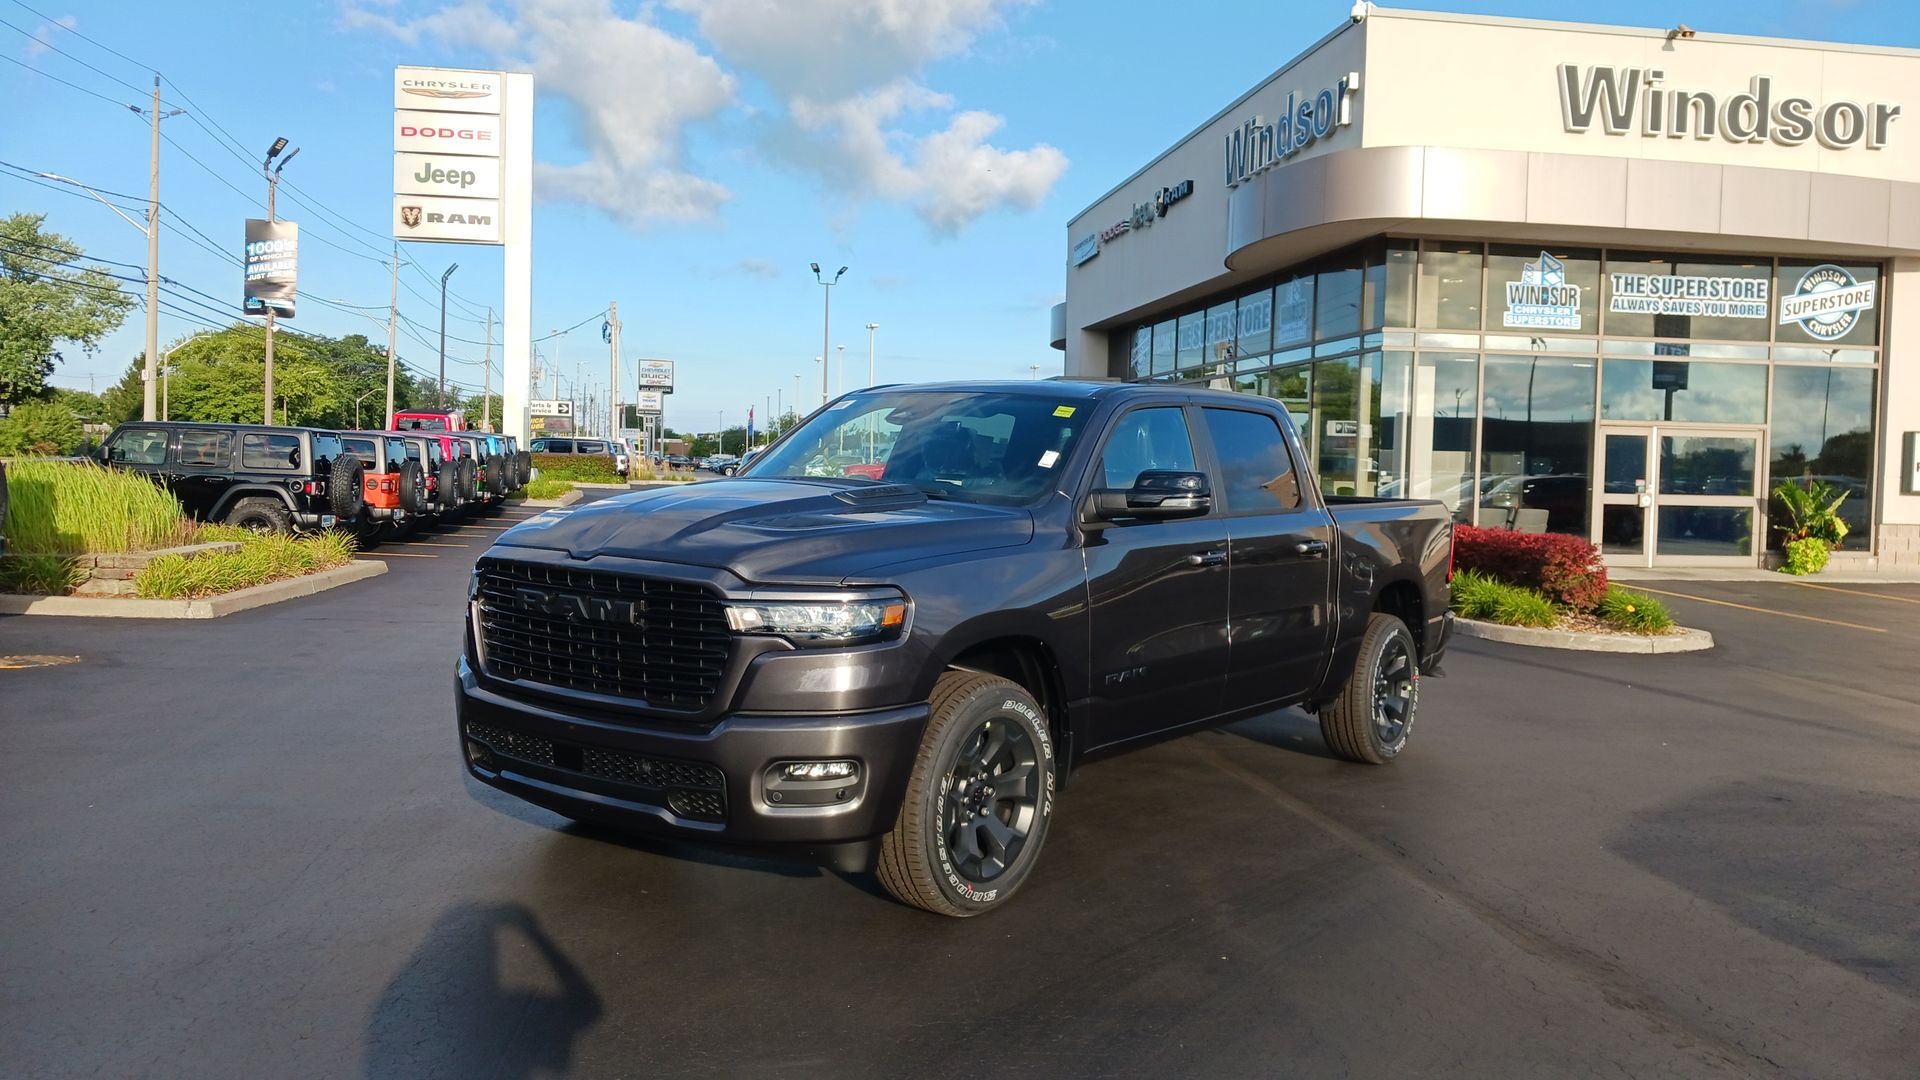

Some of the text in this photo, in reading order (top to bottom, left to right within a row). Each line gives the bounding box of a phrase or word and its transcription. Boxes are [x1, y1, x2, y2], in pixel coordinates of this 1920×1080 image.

[403, 79, 491, 91] CHRYSLER
[1557, 62, 1901, 151] Windsor
[401, 126, 492, 141] DODGE
[1225, 75, 1352, 188] Windsor
[414, 162, 475, 188] Jeep
[1164, 181, 1192, 204] RAM
[427, 212, 491, 225] RAM
[1613, 275, 1766, 299] THE SUPERSTORE
[1803, 270, 1847, 291] WINDSOR
[1509, 284, 1577, 307] WINDSOR
[1785, 289, 1871, 317] SUPERSTORE
[1514, 305, 1572, 316] CHRYSLER
[1612, 298, 1766, 317] ALWAYS SAVES YOU MORE!
[1505, 314, 1580, 327] SUPERSTORE
[1809, 313, 1853, 336] CHRYSLER
[516, 587, 636, 625] RAM
[1002, 699, 1052, 760] DUELER
